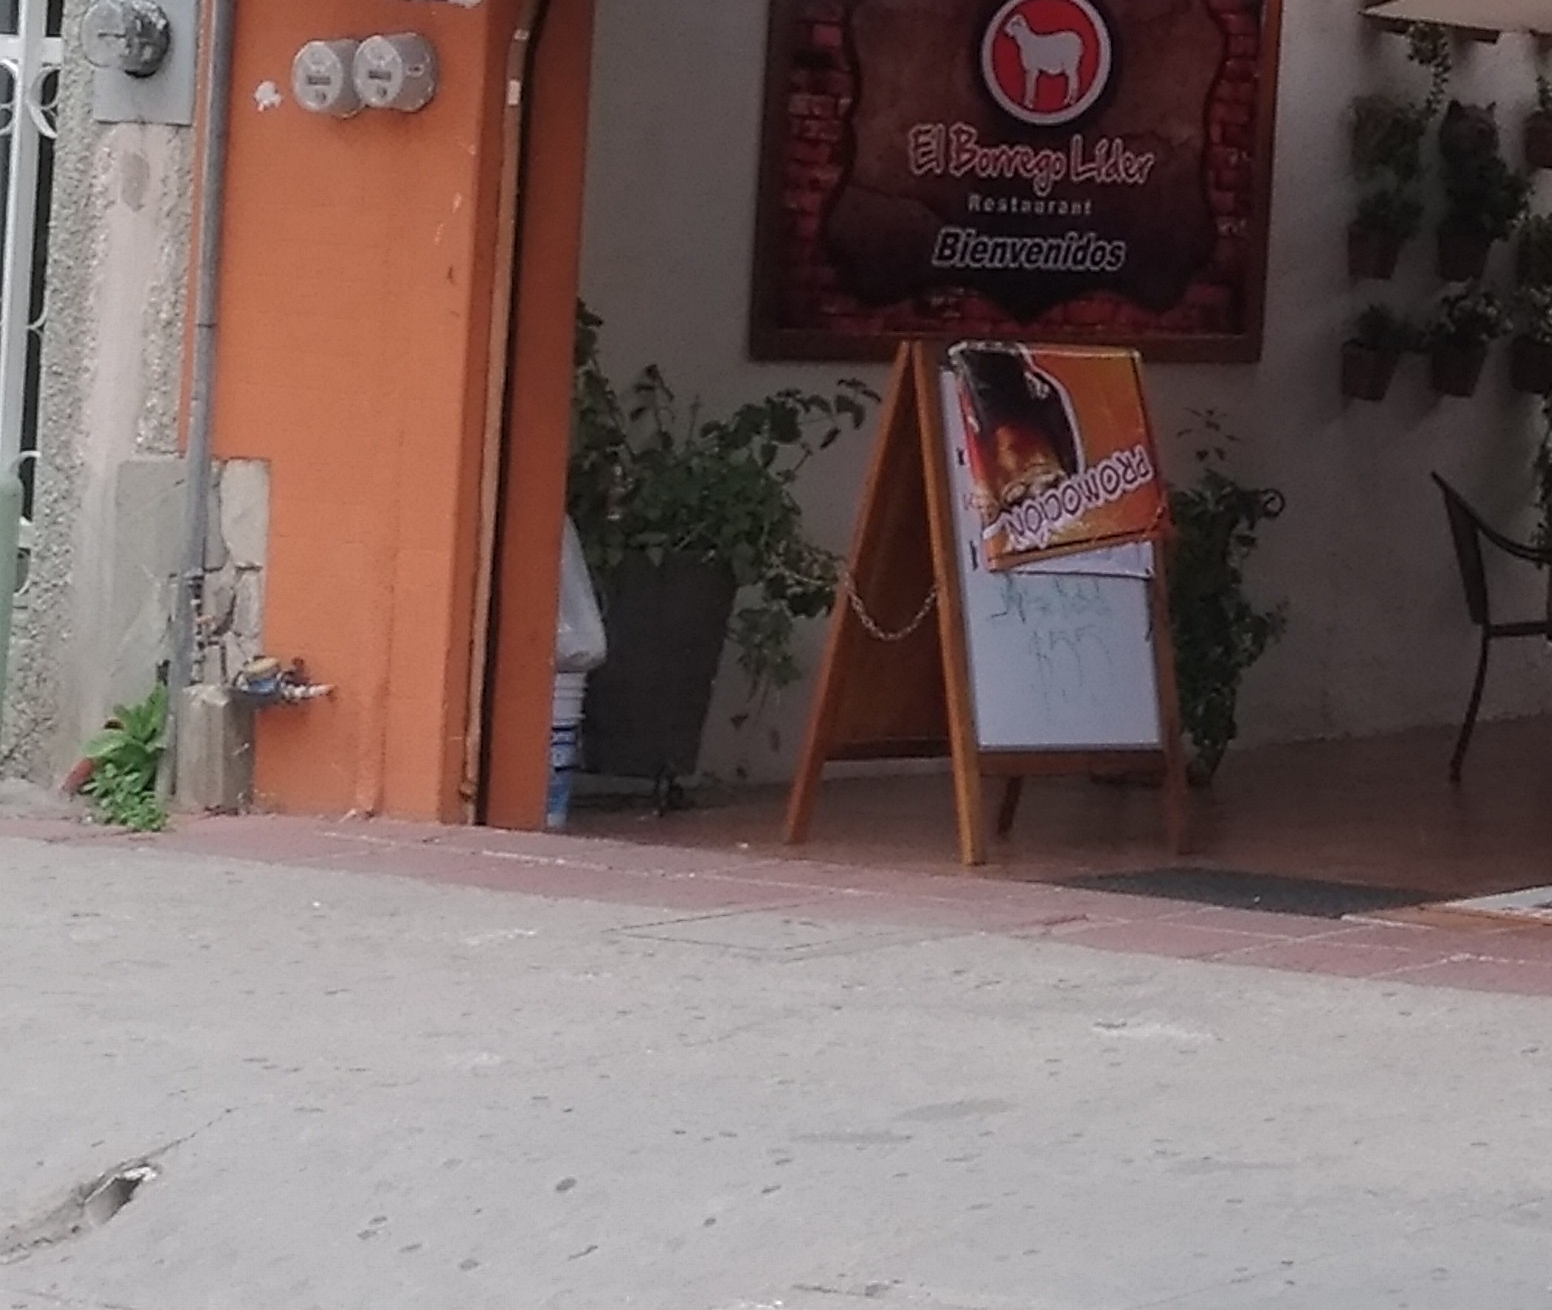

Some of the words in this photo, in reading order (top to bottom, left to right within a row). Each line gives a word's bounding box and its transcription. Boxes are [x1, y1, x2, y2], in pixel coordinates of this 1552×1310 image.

[909, 122, 946, 175] El
[950, 121, 1068, 198] Borrego
[968, 192, 1093, 217] Restaurant
[931, 224, 1127, 272] Bienvenidos
